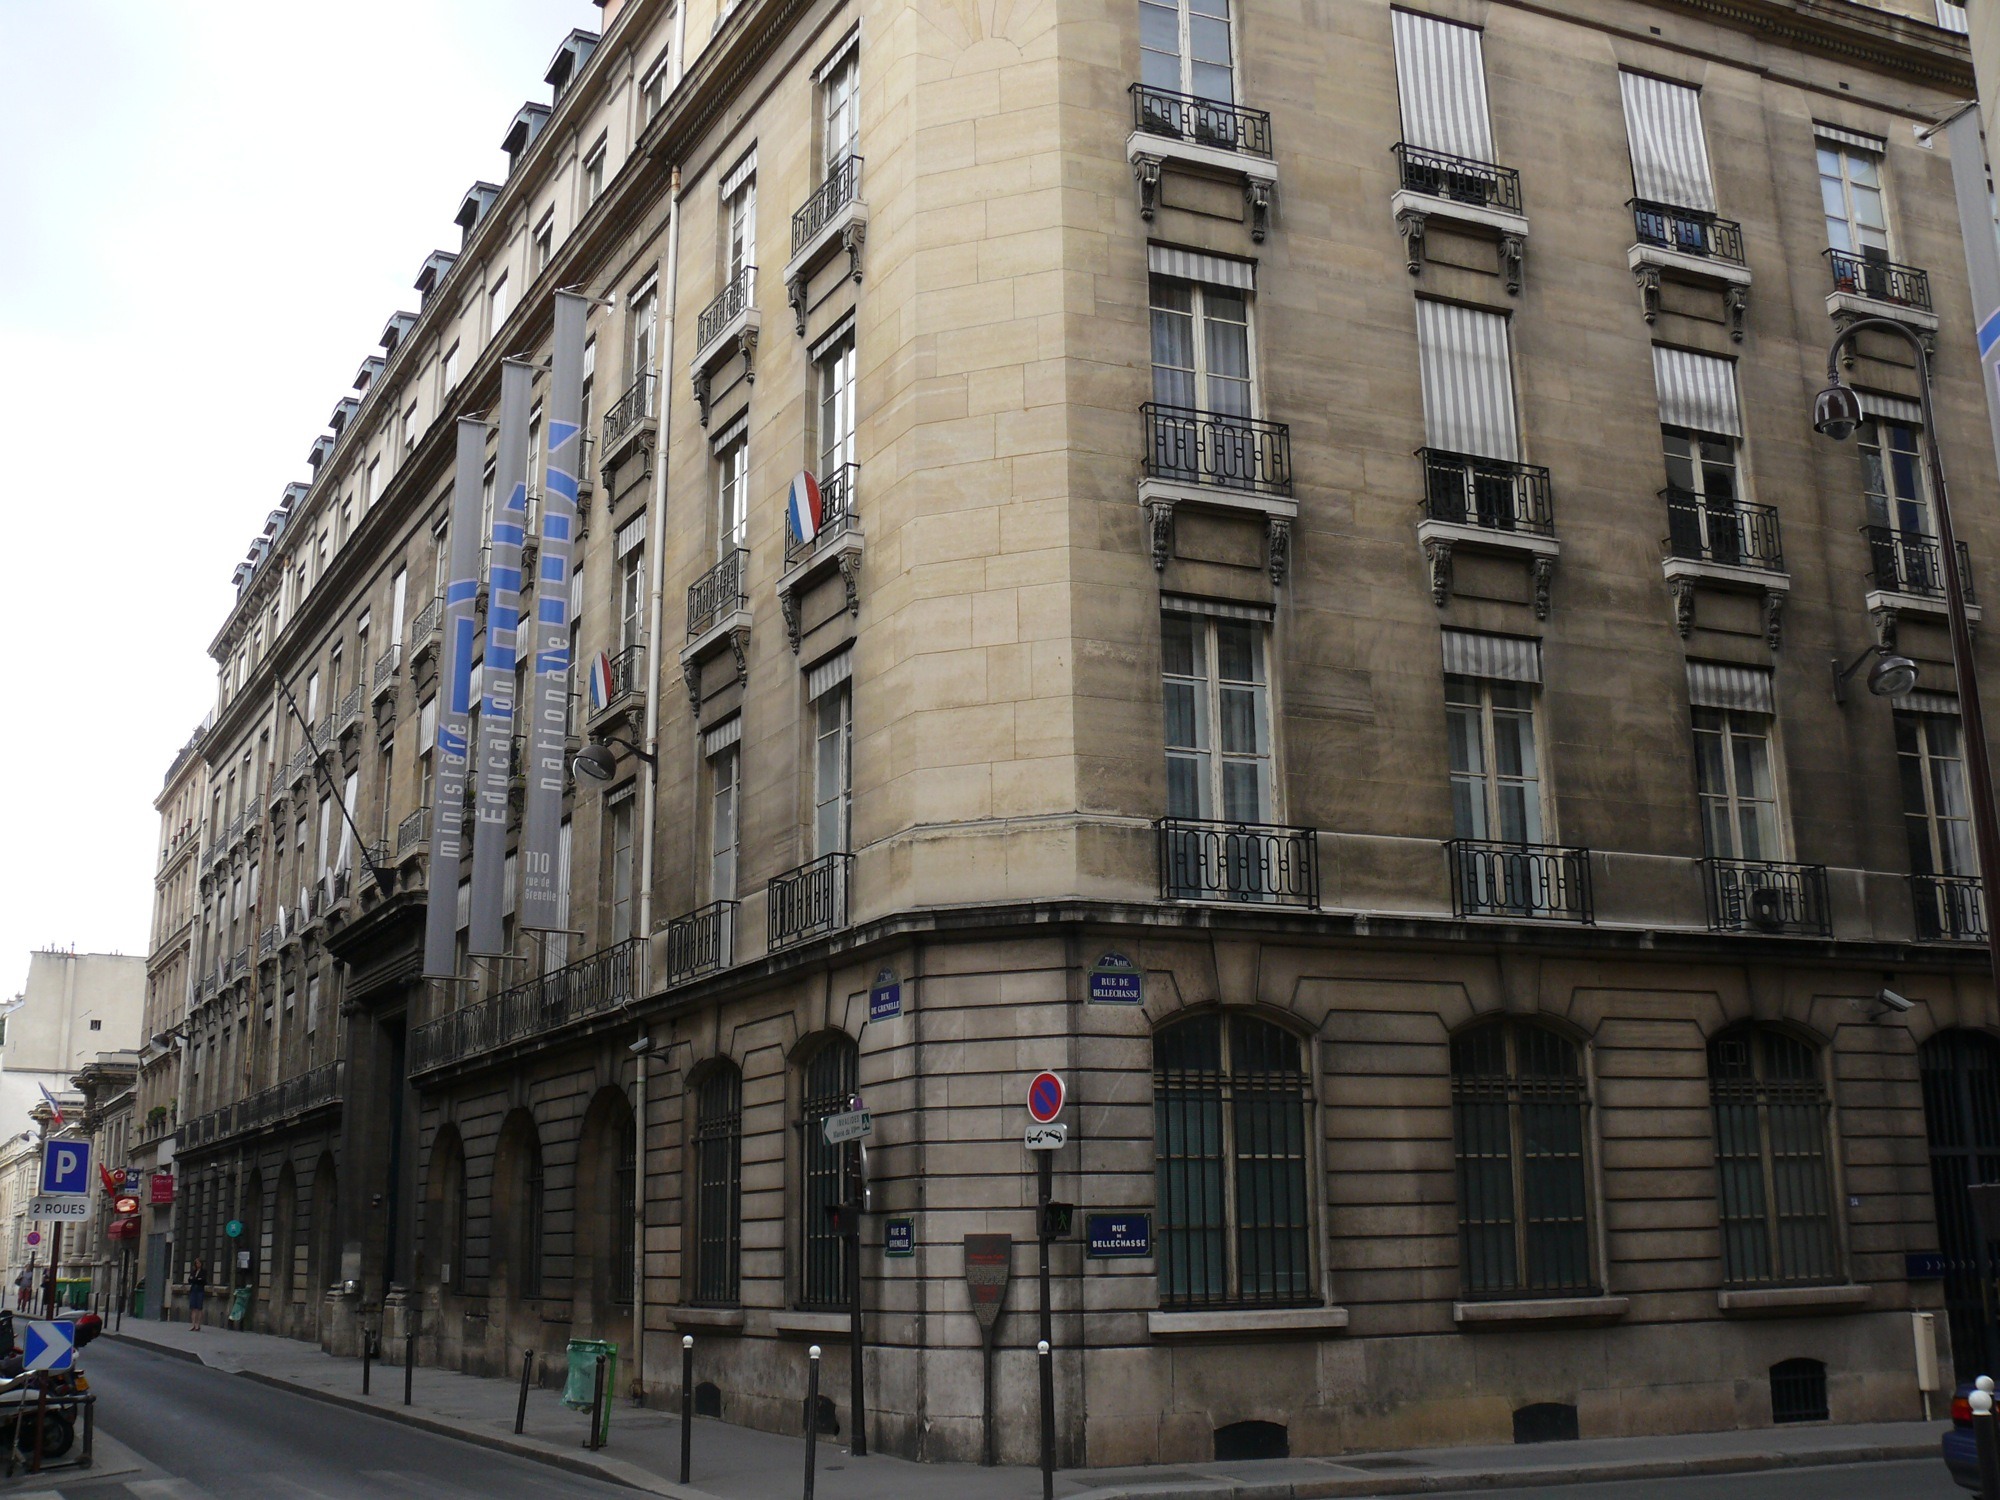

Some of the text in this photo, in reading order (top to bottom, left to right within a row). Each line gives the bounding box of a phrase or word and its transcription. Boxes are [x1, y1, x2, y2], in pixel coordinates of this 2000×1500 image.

[538, 636, 570, 791] nationale
[475, 679, 514, 824] Éducation
[437, 723, 467, 858] ministère
[525, 851, 549, 873] 110
[525, 877, 550, 887] rue de
[525, 889, 556, 901] Grenelle
[1101, 978, 1129, 987] RUE DE
[880, 992, 890, 1001] RUE
[1093, 989, 1139, 998] BELLECHASSE
[877, 1001, 900, 1013] GRENELLE
[55, 1150, 77, 1184] P
[33, 1203, 85, 1215] 2 ROUES
[890, 1227, 907, 1236] RUE DE
[1111, 1224, 1127, 1232] RUE
[889, 1239, 909, 1248] GRENELLE
[1092, 1239, 1146, 1248] BELLECHASSE
